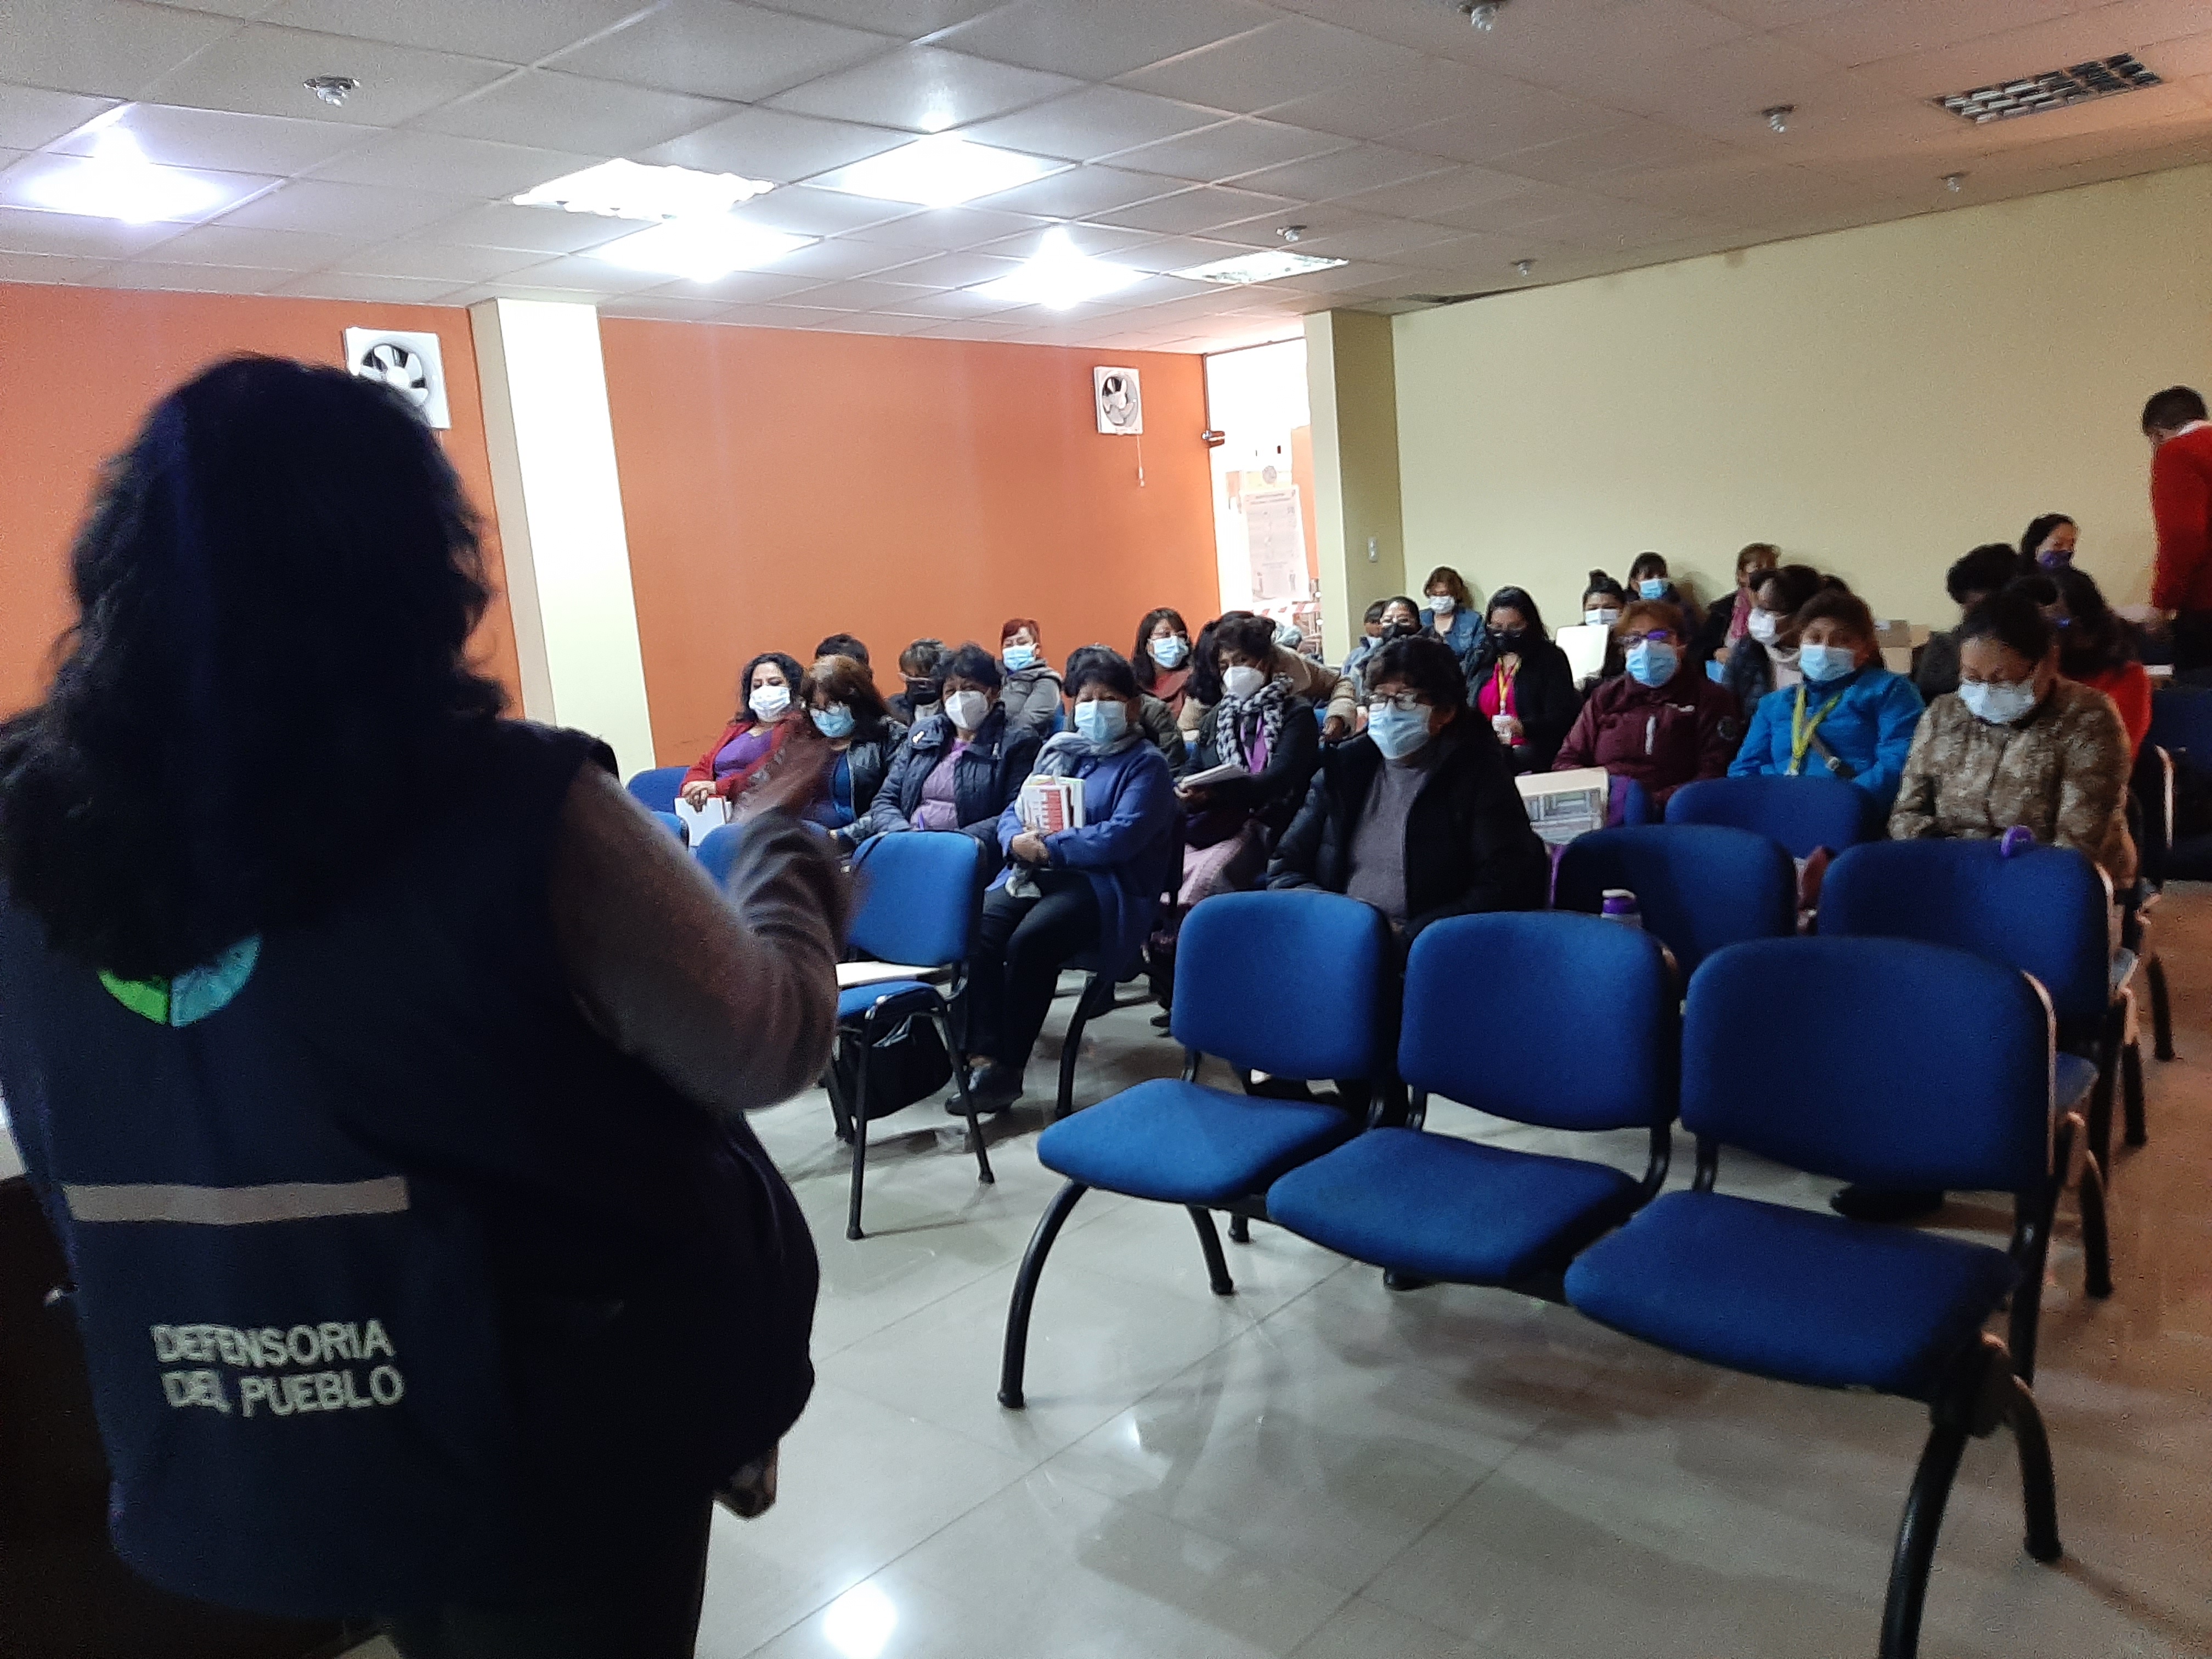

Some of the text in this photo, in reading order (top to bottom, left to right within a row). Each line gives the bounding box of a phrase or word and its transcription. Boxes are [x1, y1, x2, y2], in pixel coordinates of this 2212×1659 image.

[150, 1319, 397, 1368] DEFENSORIA
[162, 1365, 405, 1418] DEL PUEBLO
